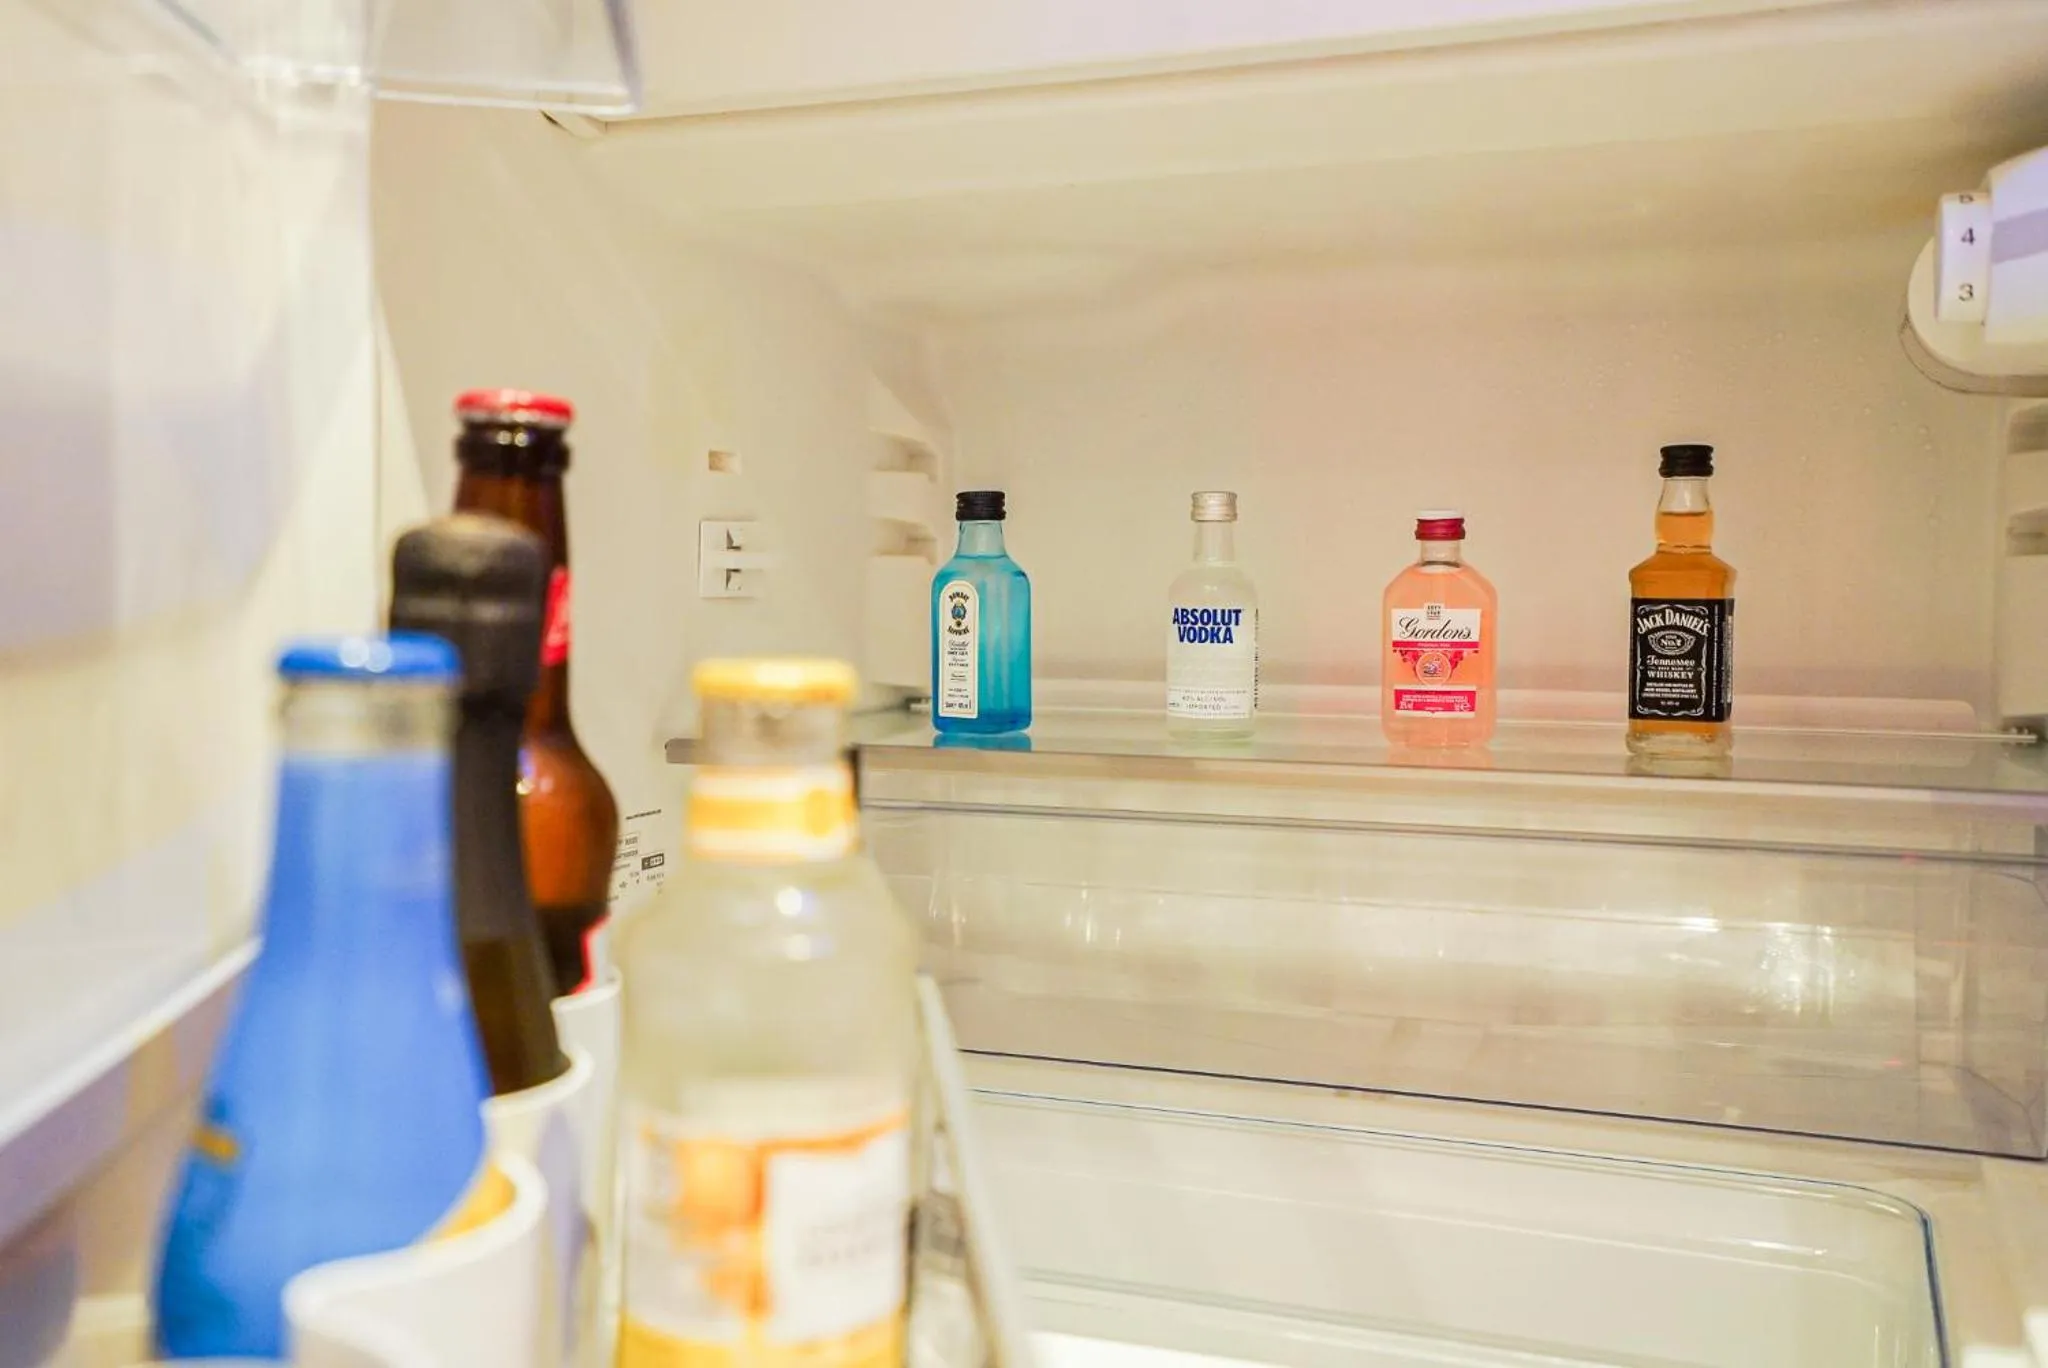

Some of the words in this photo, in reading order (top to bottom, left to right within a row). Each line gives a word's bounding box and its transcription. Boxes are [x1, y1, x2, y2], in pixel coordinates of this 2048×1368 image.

[1961, 227, 1975, 245] 4
[1959, 283, 1974, 301] 3
[1172, 607, 1242, 626] ABSOLUT
[1637, 613, 1665, 635] JACK
[1665, 608, 1711, 637] DANIEL'S
[1178, 626, 1234, 644] VODKA
[1646, 655, 1695, 667] Tennessee
[1647, 670, 1694, 680] WHISKEY
